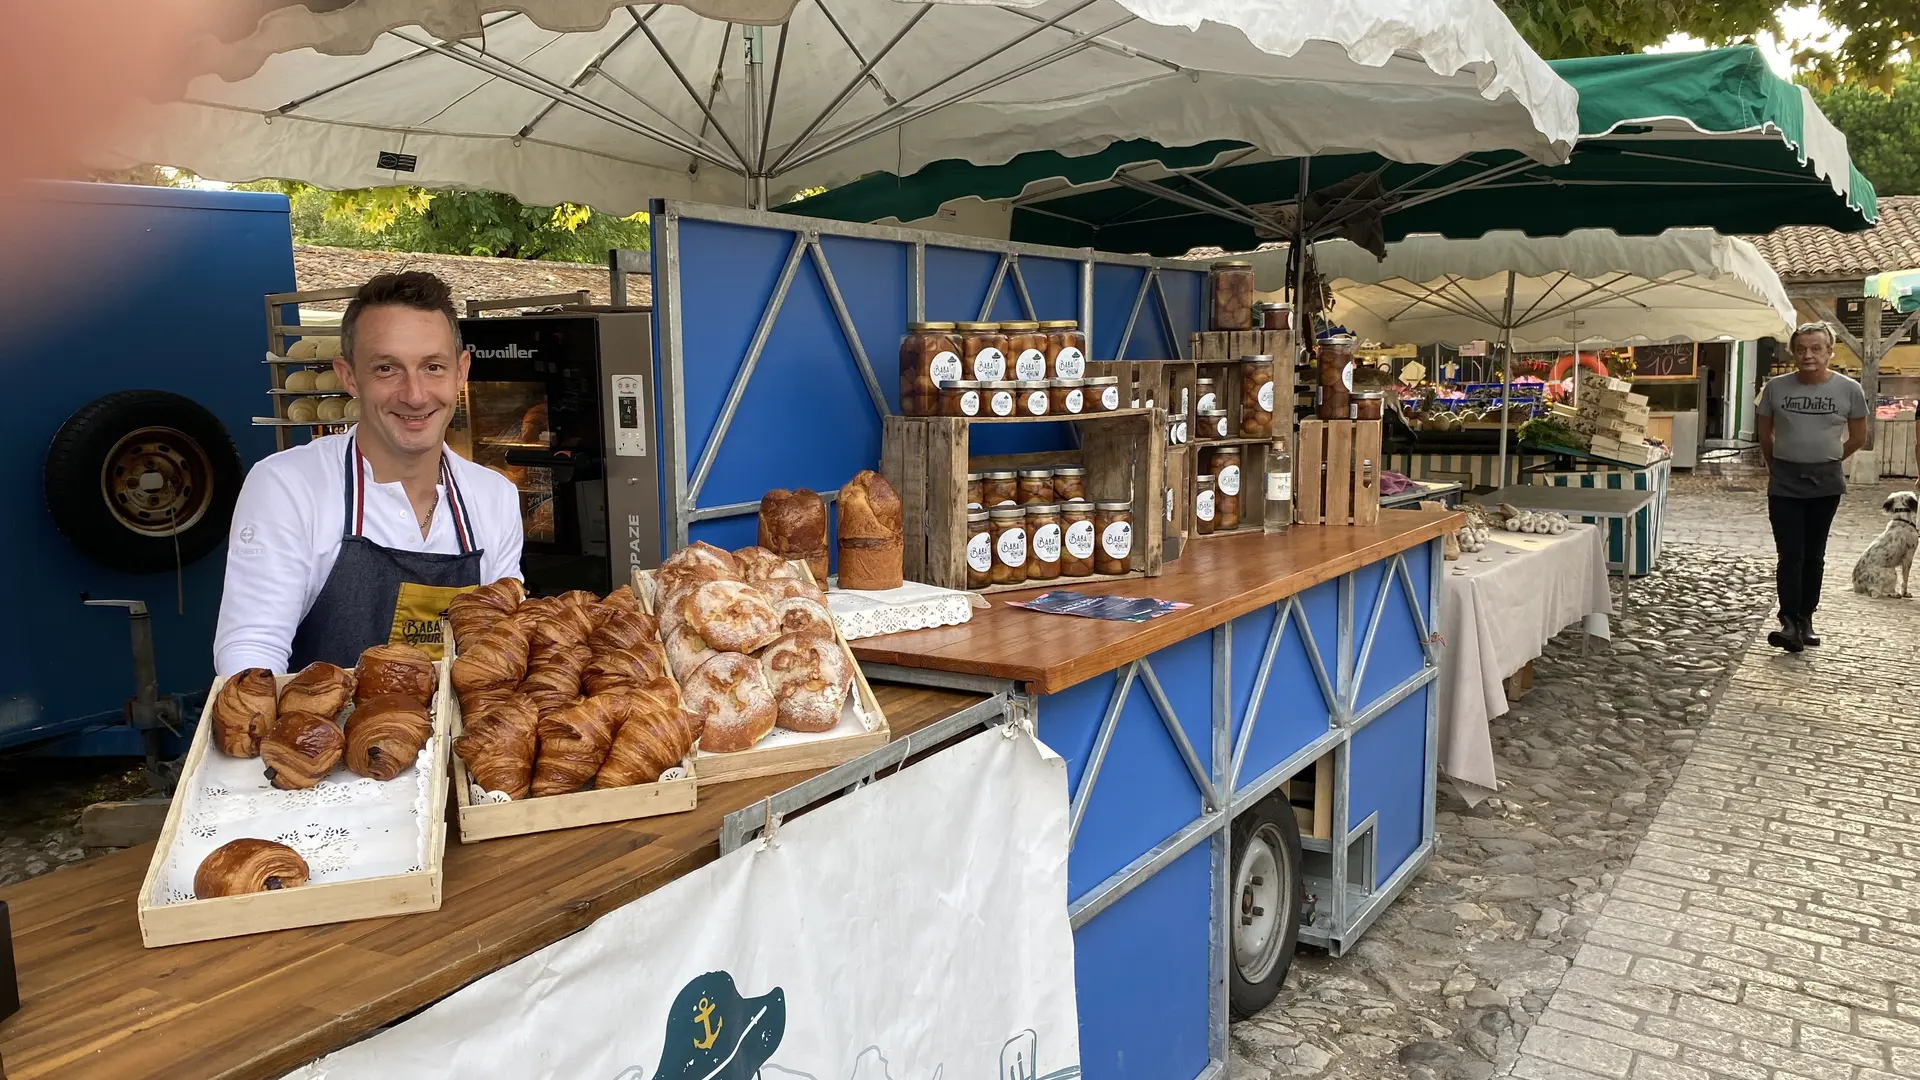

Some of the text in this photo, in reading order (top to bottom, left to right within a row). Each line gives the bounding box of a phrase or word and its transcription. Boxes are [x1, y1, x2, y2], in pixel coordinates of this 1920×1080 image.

[465, 343, 538, 359] Pavailler
[1645, 356, 1674, 376] 10
[1802, 395, 1837, 412] Dutch
[402, 619, 441, 638] BABA
